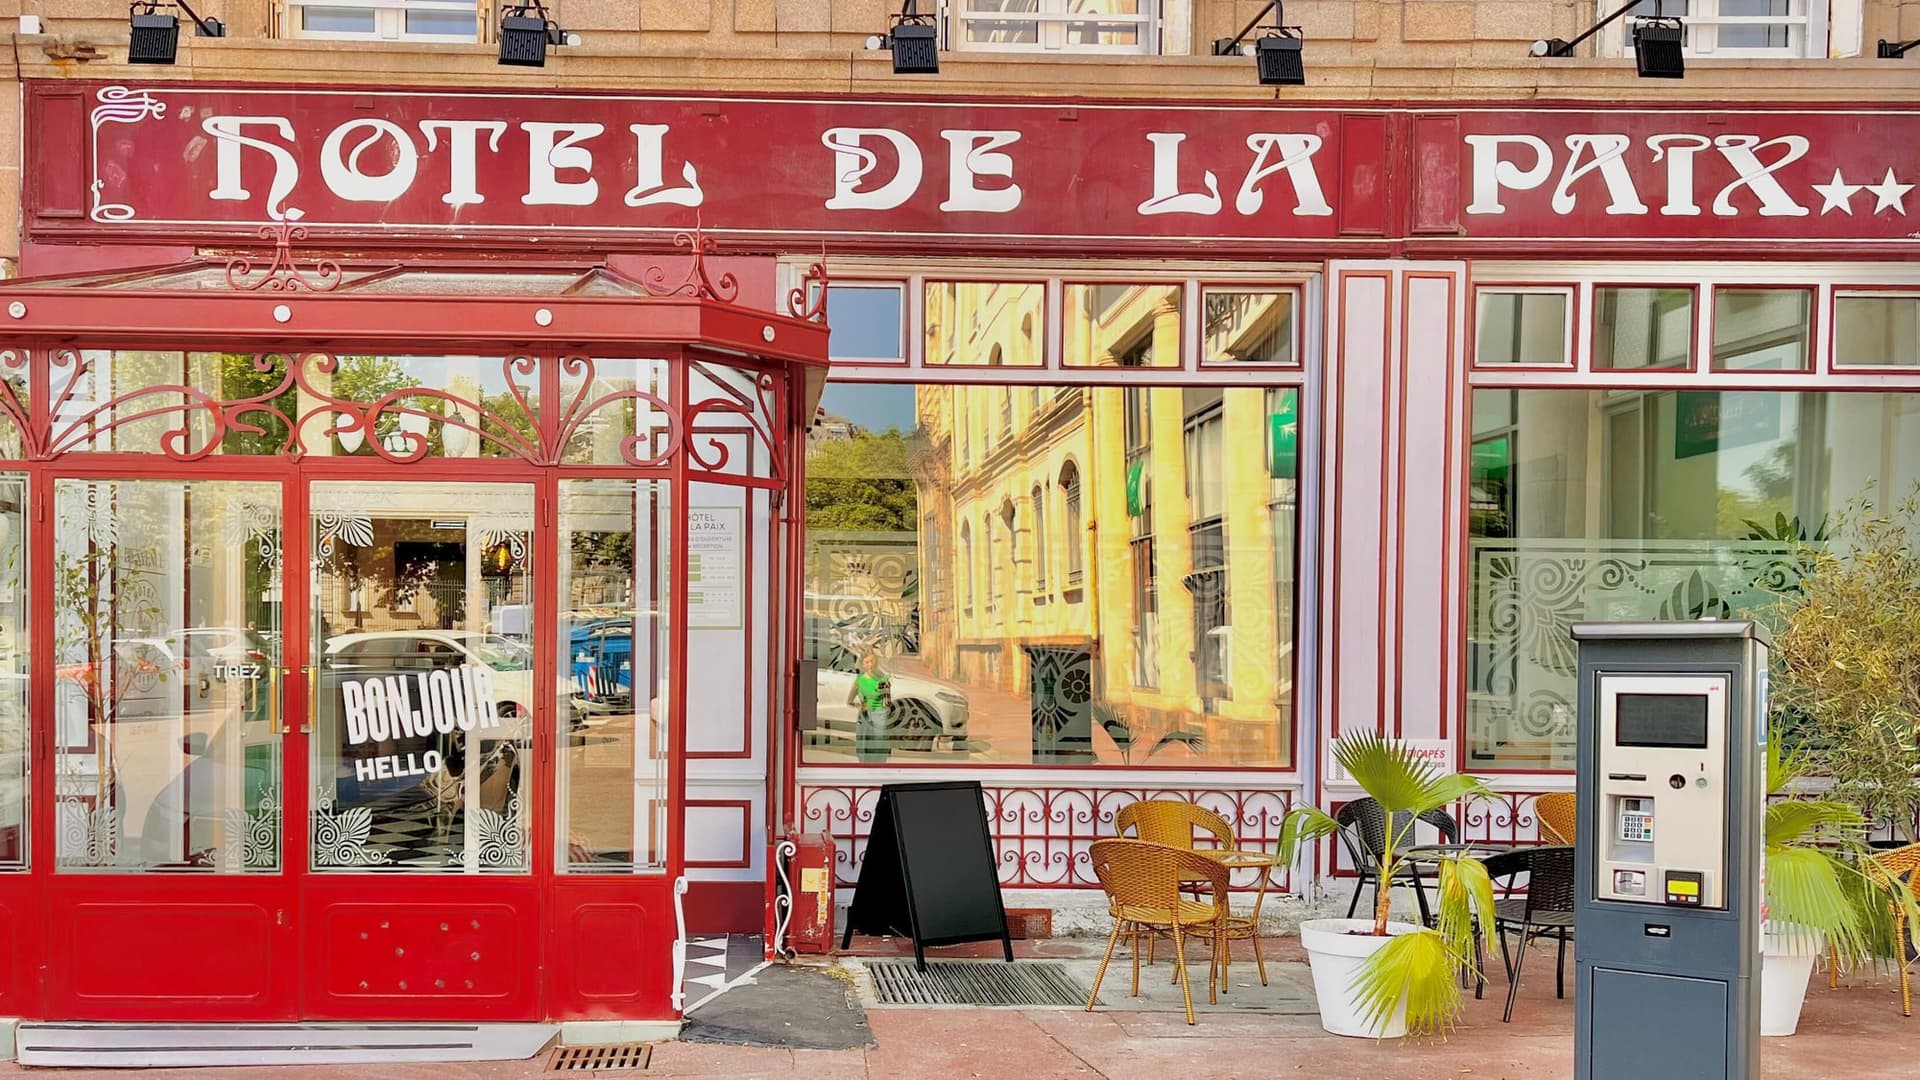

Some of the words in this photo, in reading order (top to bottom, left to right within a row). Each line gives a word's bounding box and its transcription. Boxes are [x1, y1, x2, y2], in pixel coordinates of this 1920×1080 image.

[202, 115, 704, 221] HOTEL
[821, 126, 1024, 213] DE
[1138, 132, 1334, 217] LA
[1463, 132, 1811, 217] PAIX
[704, 523, 726, 531] PAIX
[213, 664, 261, 680] TIREZ
[341, 663, 501, 746] BONJOUR
[354, 750, 442, 782] HELLO
